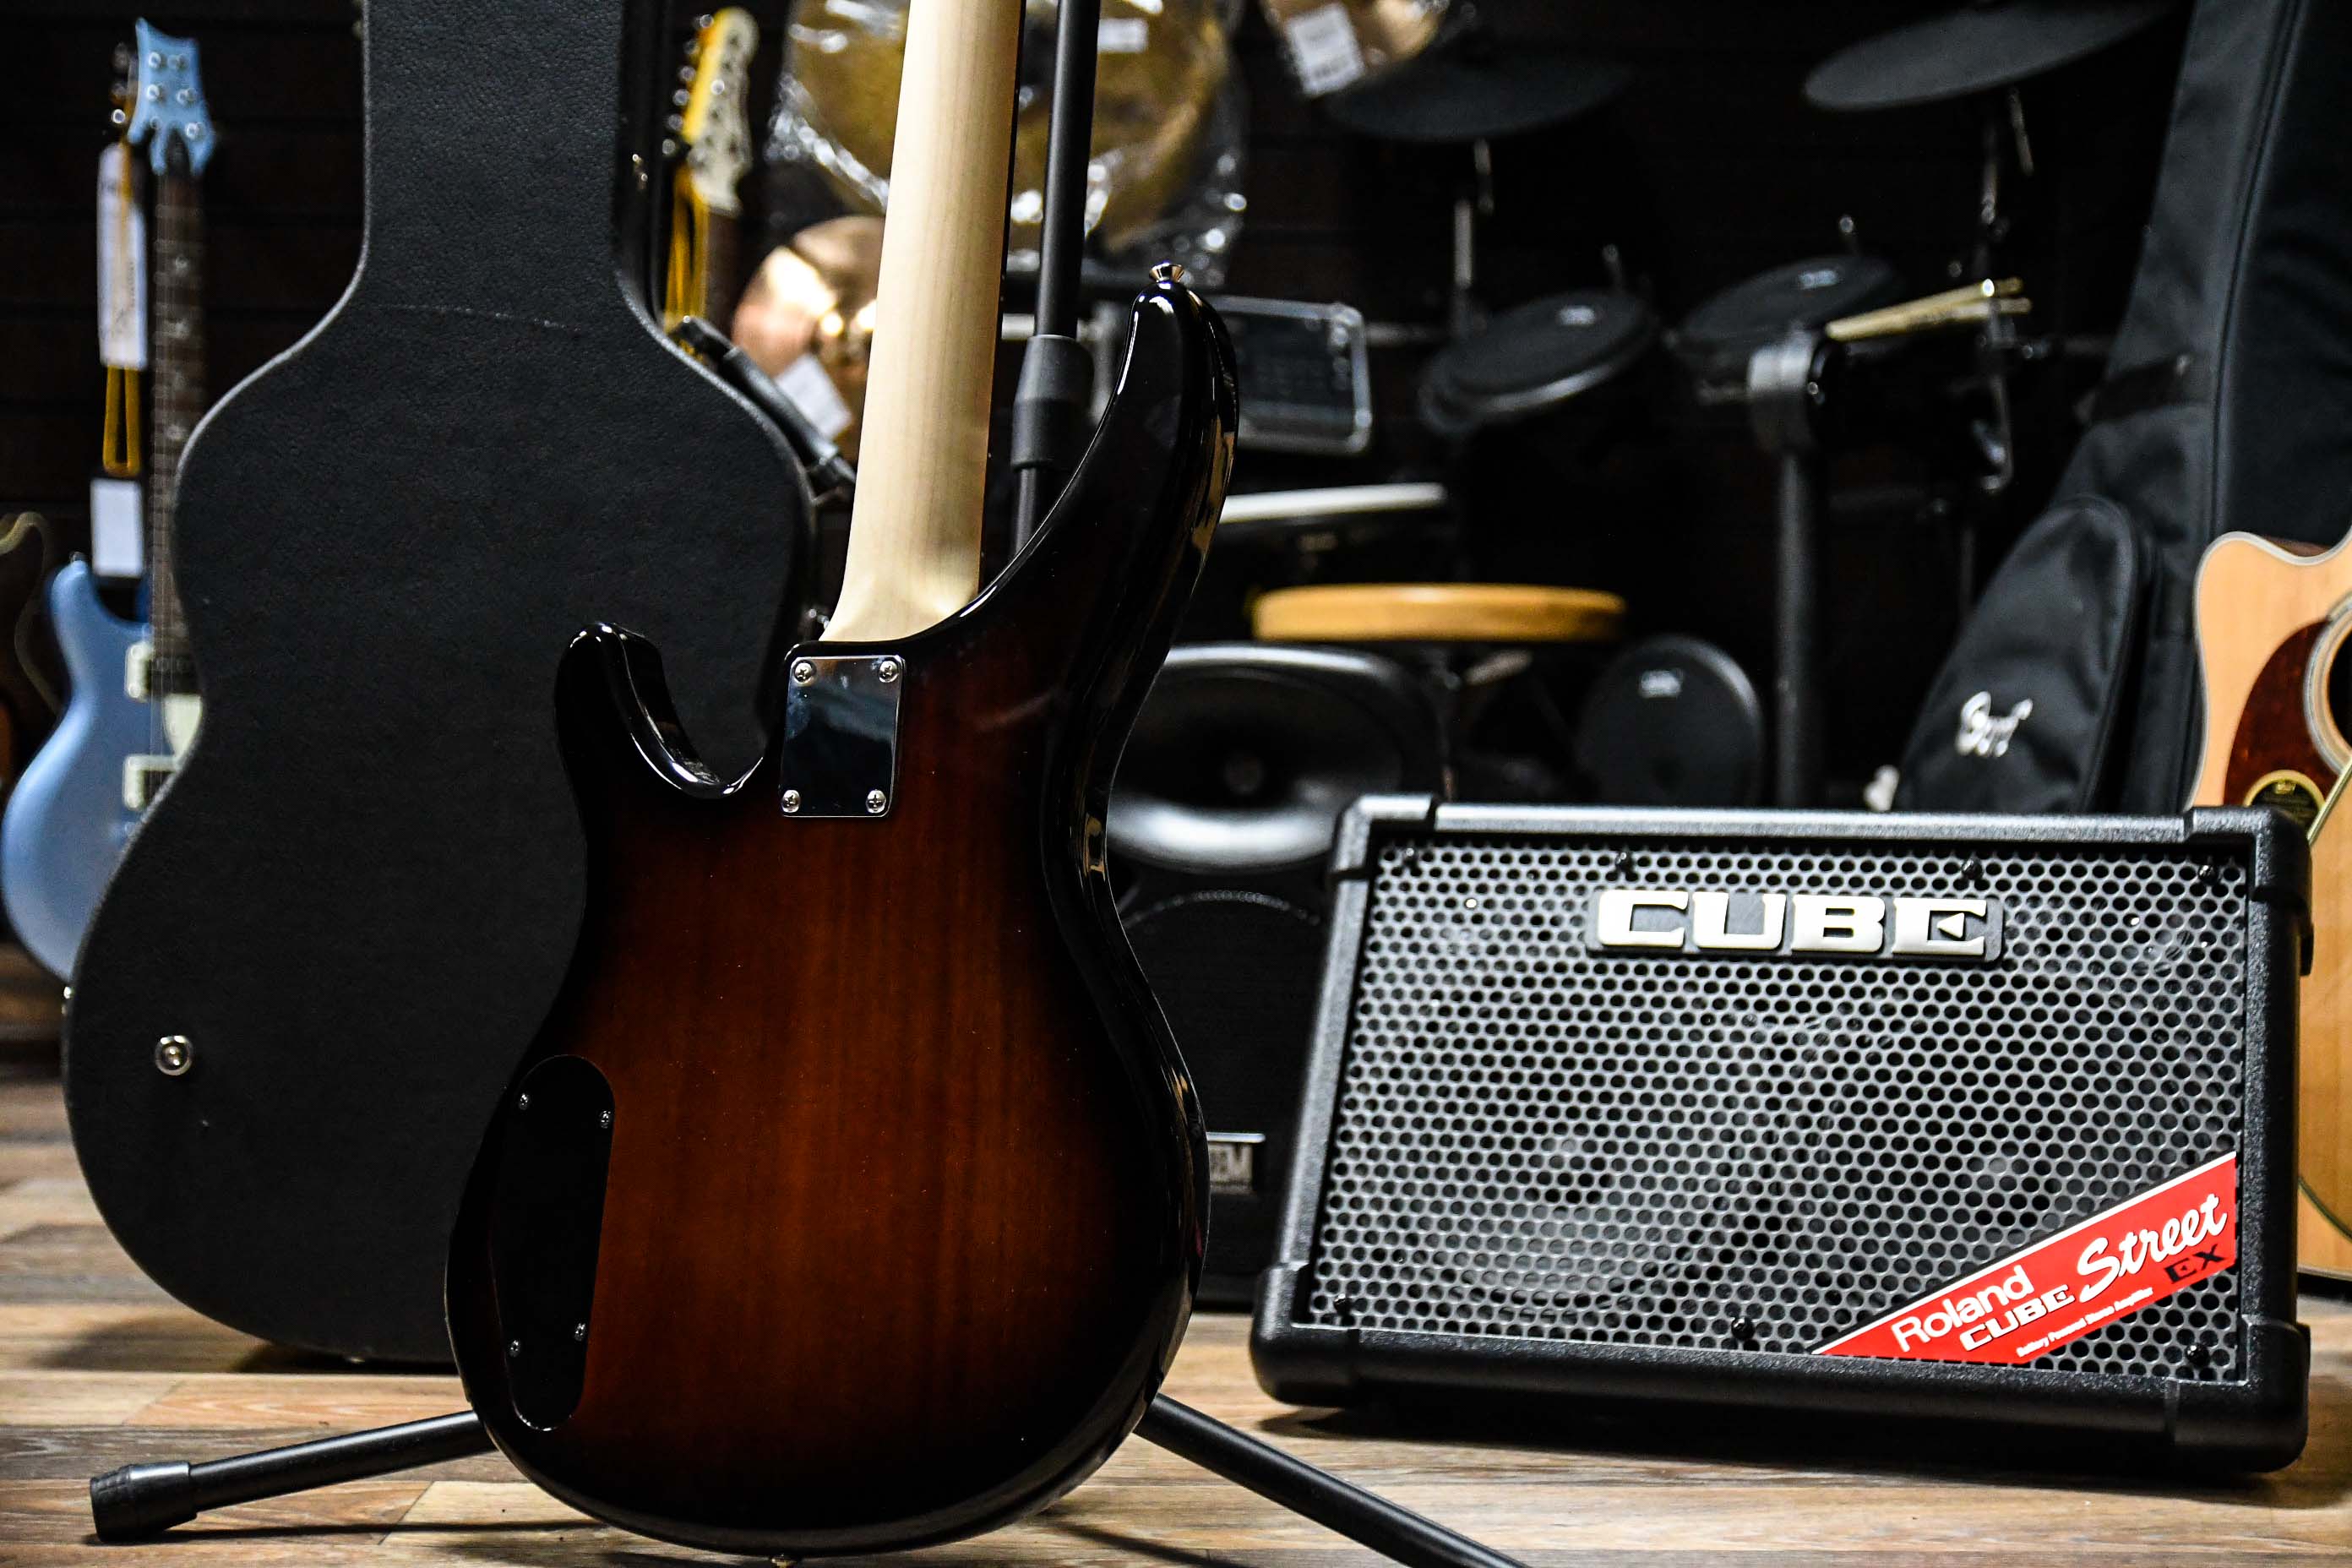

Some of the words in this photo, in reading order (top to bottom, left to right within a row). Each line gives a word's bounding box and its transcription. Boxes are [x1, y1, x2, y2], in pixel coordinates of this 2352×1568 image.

[1598, 890, 1988, 956] CUBE
[1959, 1284, 2076, 1352] CUBE
[2077, 1193, 2228, 1304] Street
[2164, 1243, 2226, 1284] EX
[1891, 1265, 2035, 1353] Roland
